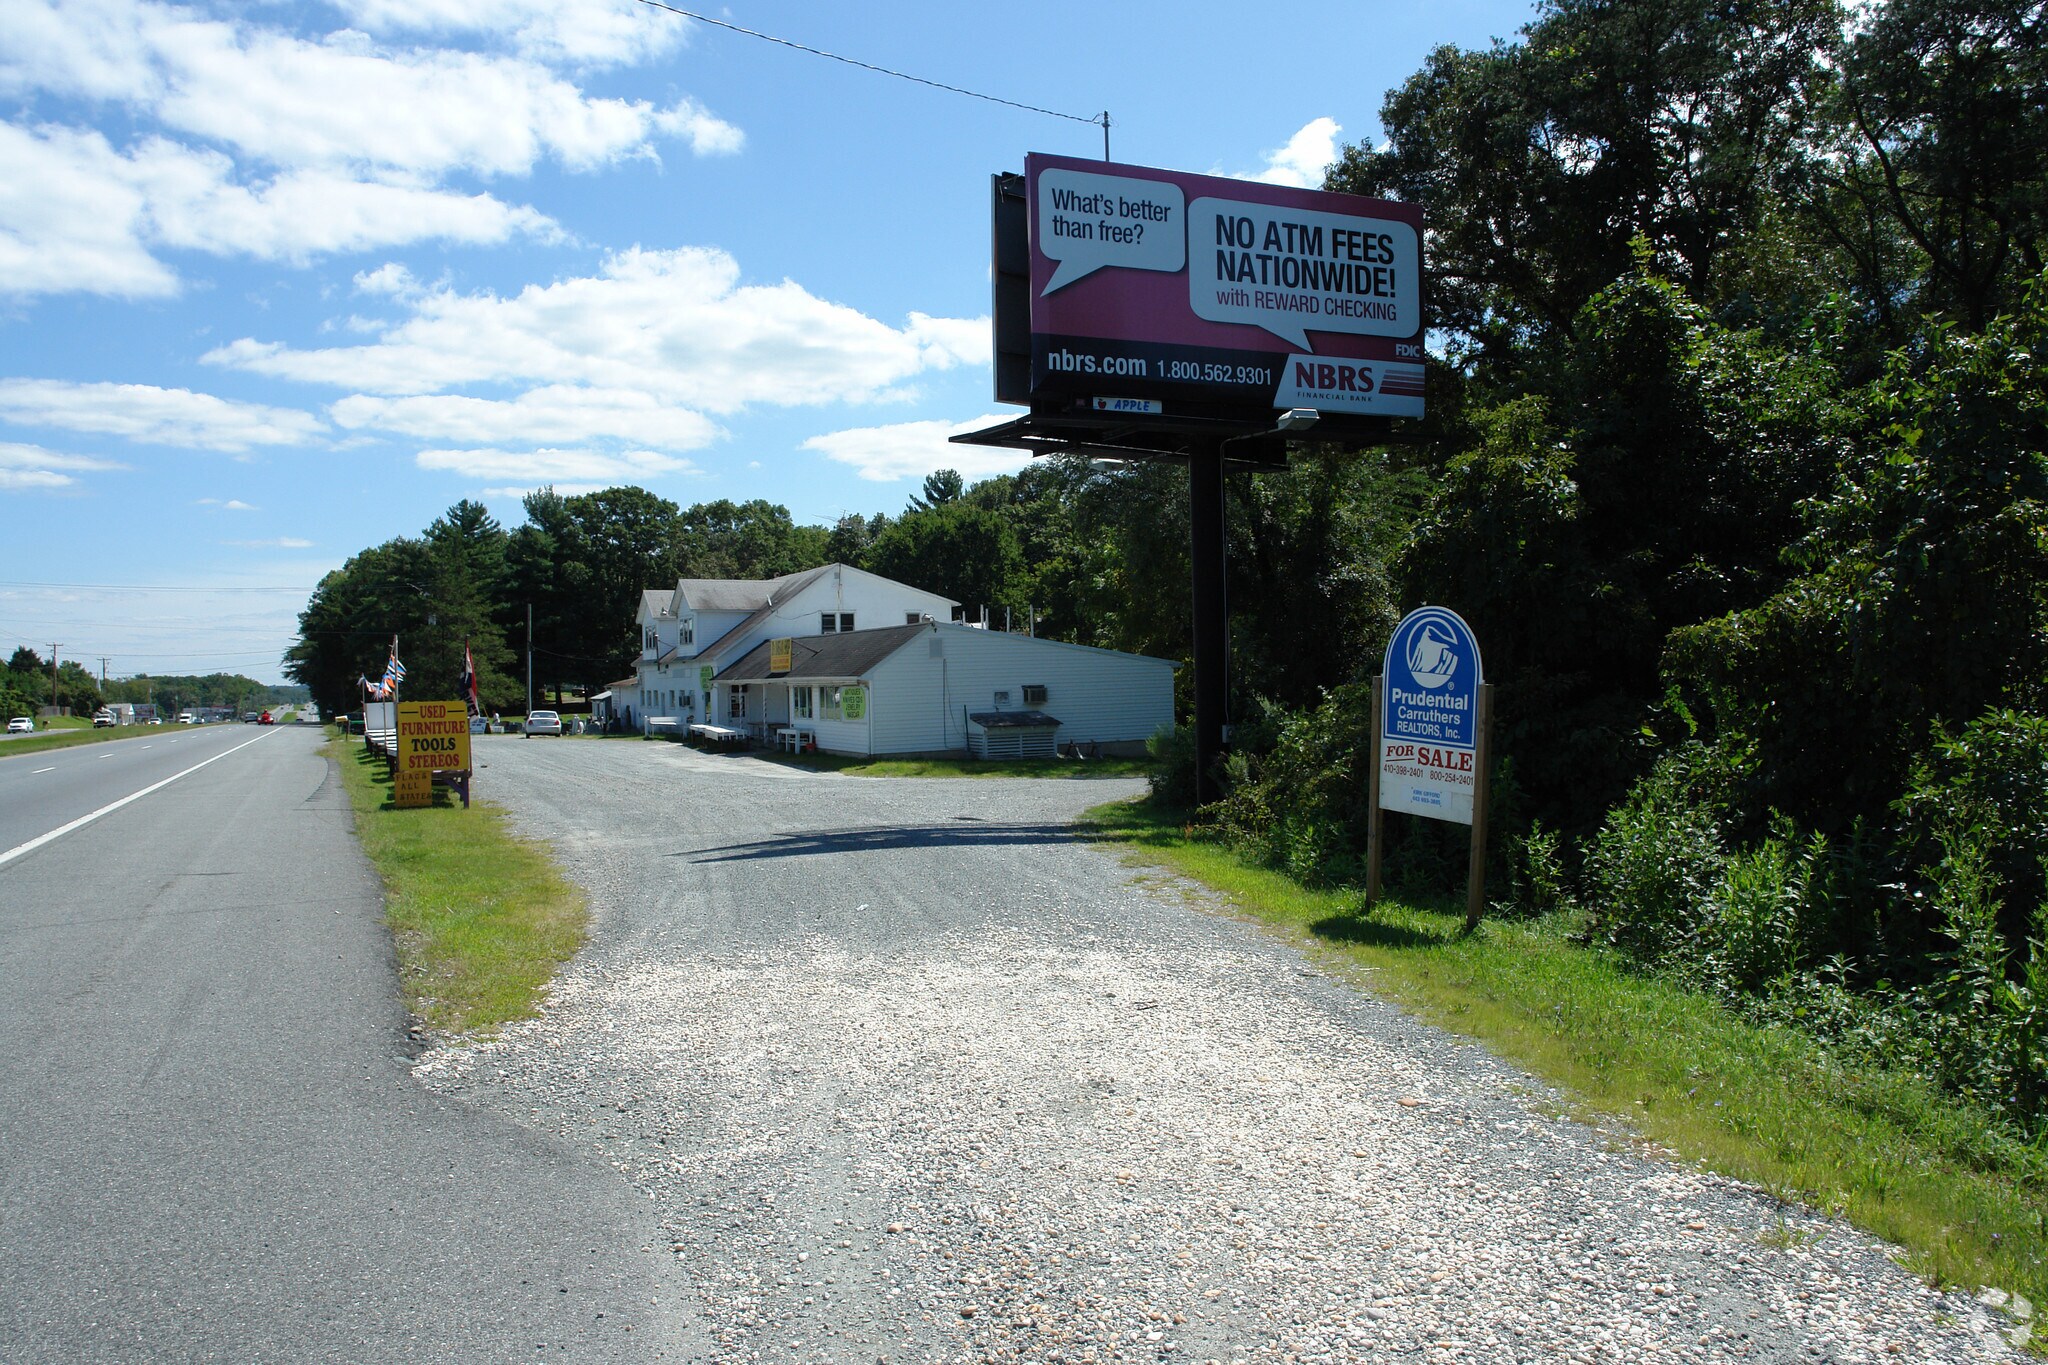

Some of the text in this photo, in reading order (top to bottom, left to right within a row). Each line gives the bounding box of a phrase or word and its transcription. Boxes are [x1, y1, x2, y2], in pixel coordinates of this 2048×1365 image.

[1051, 187, 1171, 223] What's better
[1052, 215, 1144, 245] than free?
[1216, 214, 1395, 265] NO ATM FEES
[1216, 249, 1396, 298] NATIONWIDE!
[1216, 288, 1397, 321] with REWARD CHECKING
[1395, 343, 1421, 358] FDIC
[1048, 348, 1272, 386] nbrs.com 1.800.562.9301
[1295, 361, 1375, 393] NBRS
[1114, 400, 1150, 412] APPLE
[1297, 391, 1373, 403] FINANCIAL BANK
[1392, 687, 1469, 711] Prudential
[420, 705, 447, 719] USED
[1397, 705, 1461, 725] Carruthers
[401, 720, 466, 736] FURNITURE
[1397, 720, 1461, 739] REALTORS, Inc.
[411, 738, 456, 752] TOOLS
[409, 753, 460, 769] STEREOS
[1386, 745, 1473, 772] FOR SALE
[396, 772, 427, 782] FLAGS
[1383, 763, 1474, 786] 410-398-2401 800-254-2401
[401, 782, 419, 791] ALL
